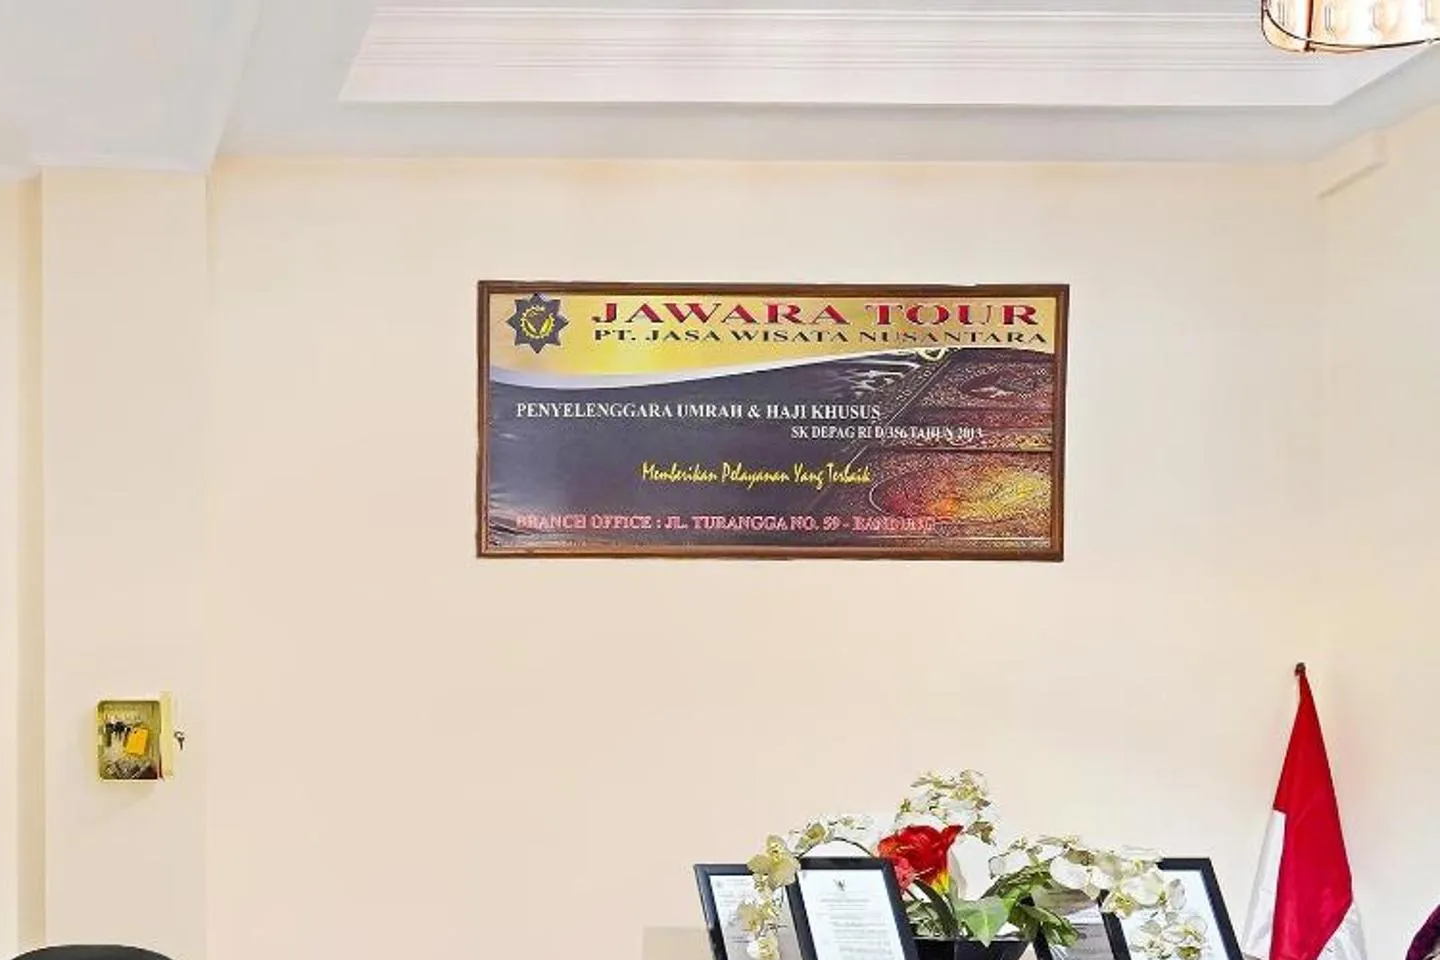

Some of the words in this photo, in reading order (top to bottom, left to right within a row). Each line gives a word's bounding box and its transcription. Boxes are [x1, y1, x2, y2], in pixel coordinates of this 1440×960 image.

[591, 303, 851, 325] JAWARA
[864, 304, 1039, 326] TOUR
[594, 329, 636, 341] PT.
[645, 330, 721, 341] JASA
[731, 330, 849, 343] WISATA
[859, 331, 1047, 343] NUSANTARA
[516, 402, 673, 418] PENYELENGGARA
[676, 403, 744, 419] UMRAH
[746, 404, 761, 418] &
[766, 404, 807, 419] HAJI
[811, 405, 881, 420] KHUSUS
[791, 426, 809, 439] SK
[811, 426, 856, 439] DEPAG
[857, 426, 873, 439] RI
[910, 426, 953, 440] TAHUN
[641, 461, 718, 483] Memberikan
[721, 461, 791, 489] Pelayanan
[793, 463, 824, 490] Yang
[825, 462, 873, 484] Terbaik
[516, 514, 587, 530] BRANCH
[590, 514, 652, 530] OFFICE
[664, 515, 688, 530] JL.
[691, 515, 789, 531] TURANGGA
[790, 515, 820, 531] NO.
